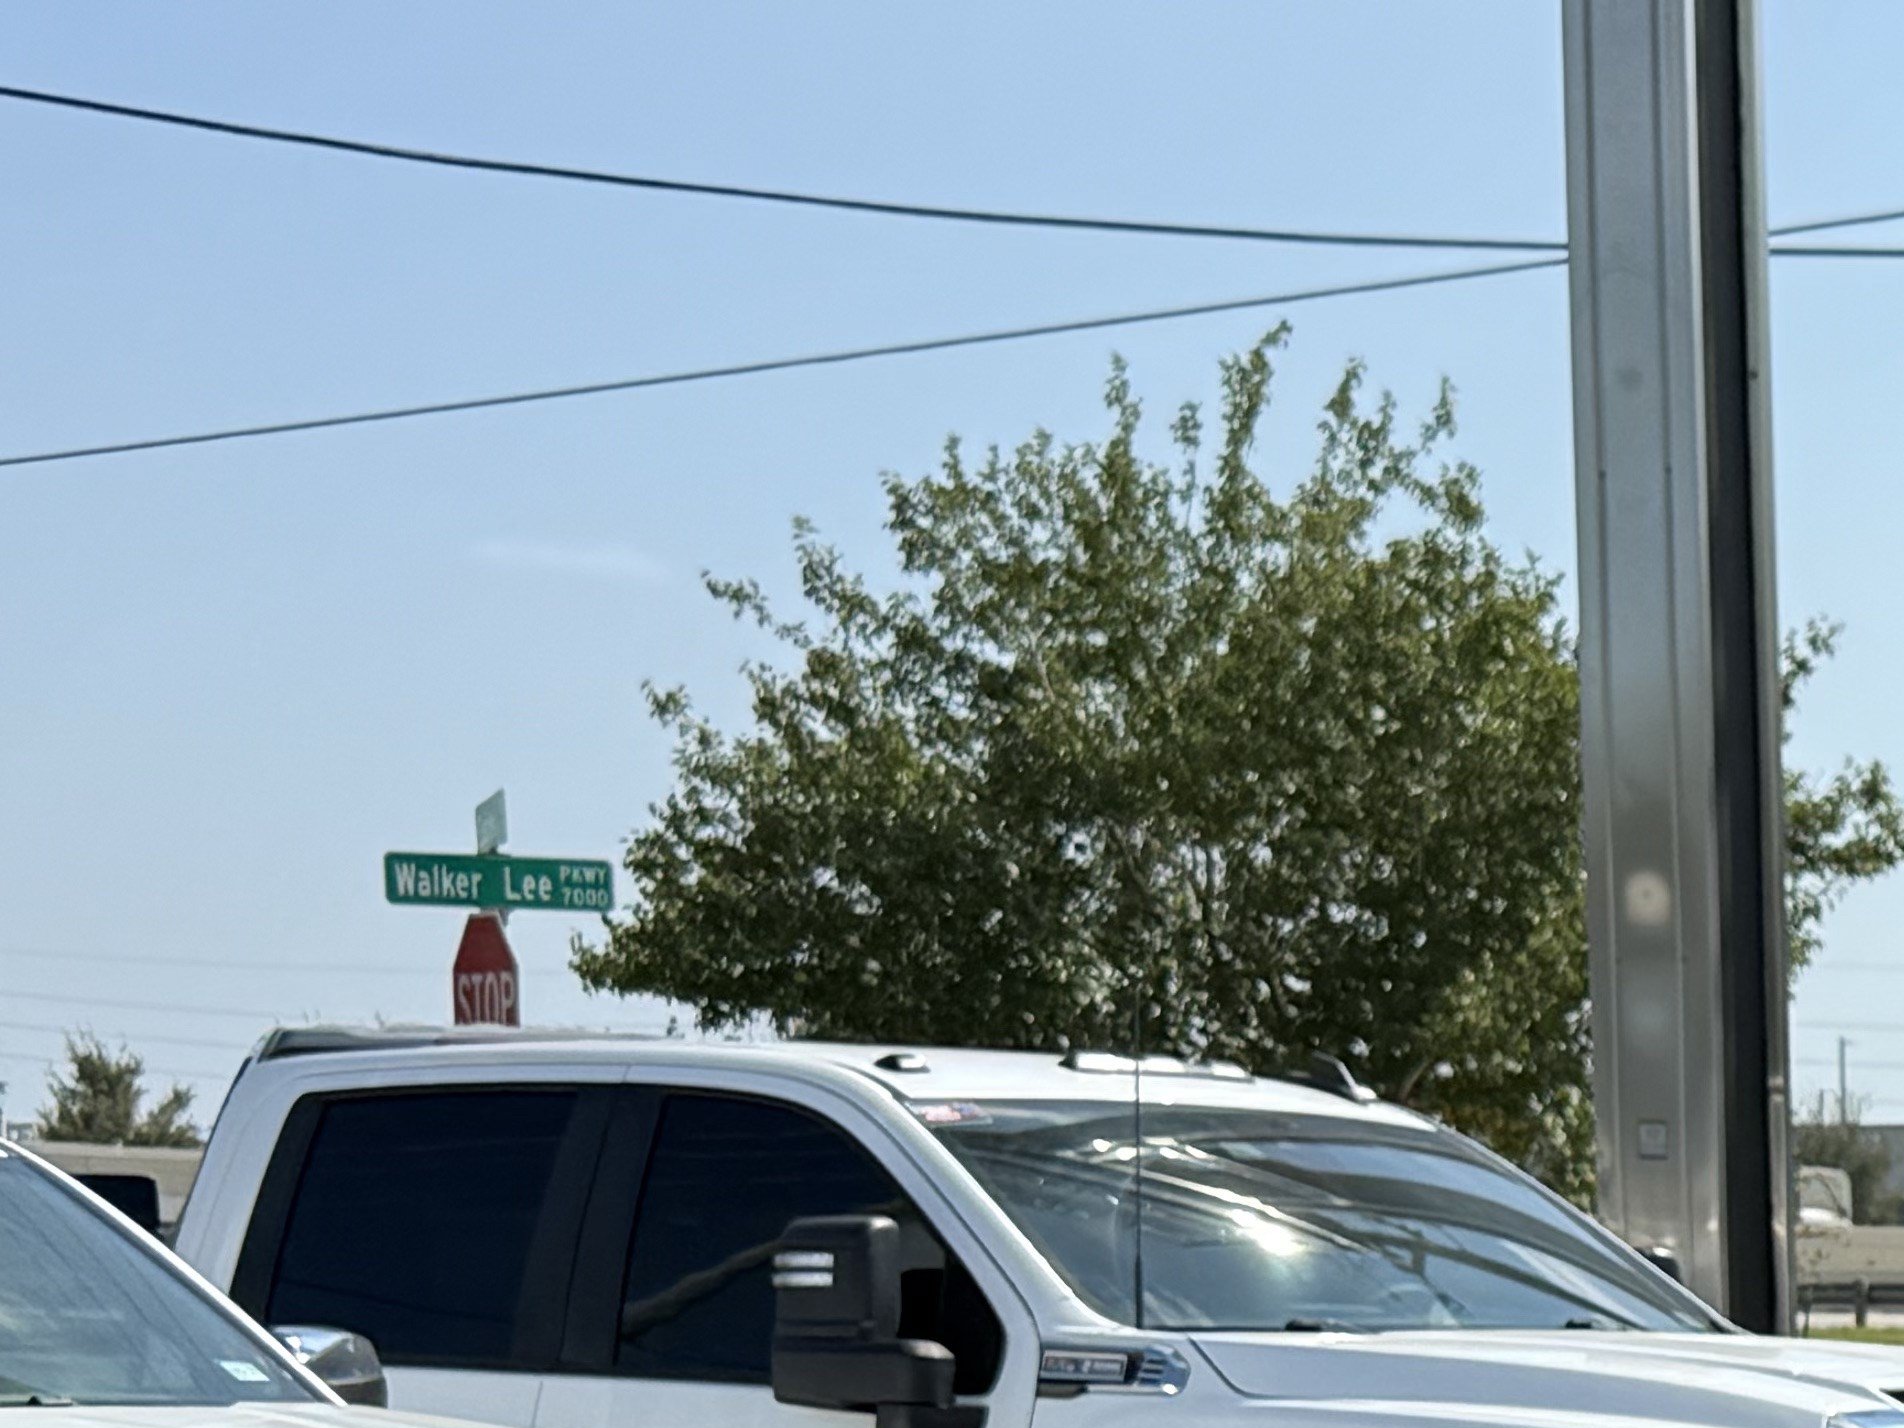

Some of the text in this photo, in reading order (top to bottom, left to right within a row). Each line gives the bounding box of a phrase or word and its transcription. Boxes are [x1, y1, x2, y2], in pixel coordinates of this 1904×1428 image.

[394, 863, 608, 901] Walker Lee PKWY
[561, 887, 609, 907] 7000
[456, 971, 515, 1026] STOP
